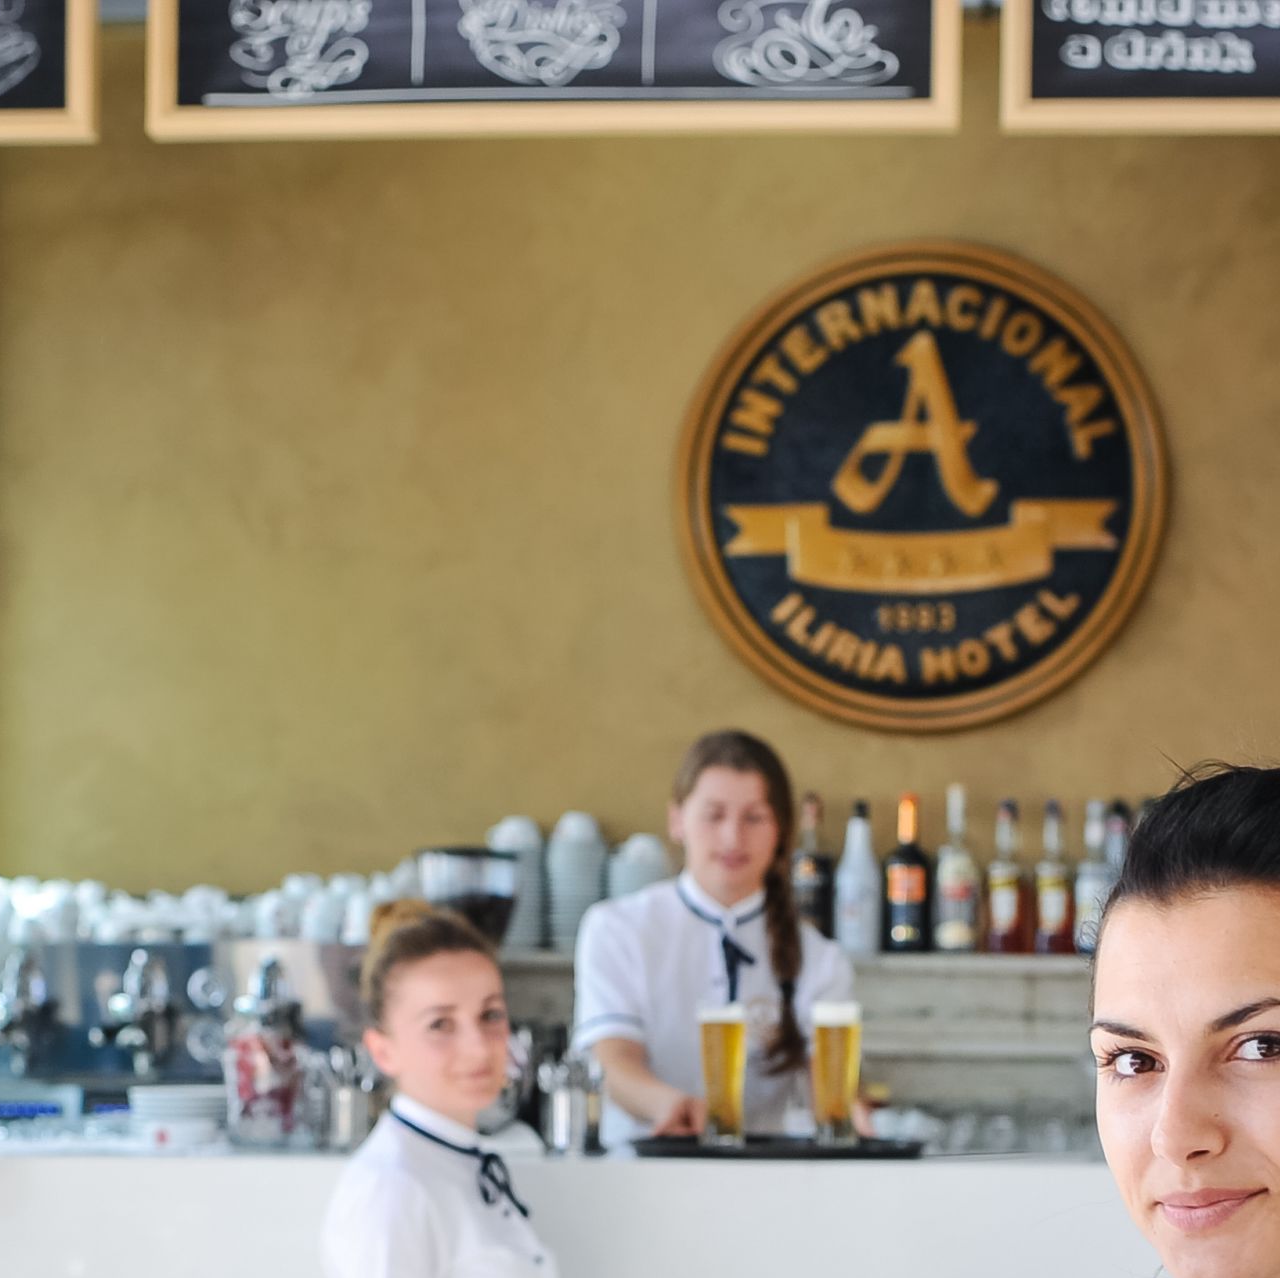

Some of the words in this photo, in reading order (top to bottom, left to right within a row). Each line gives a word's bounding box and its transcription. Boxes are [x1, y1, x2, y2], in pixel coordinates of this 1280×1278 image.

[723, 280, 1116, 459] INTERNACIONAL
[770, 592, 908, 684] ILIRIA
[921, 588, 1081, 685] HOTEL
